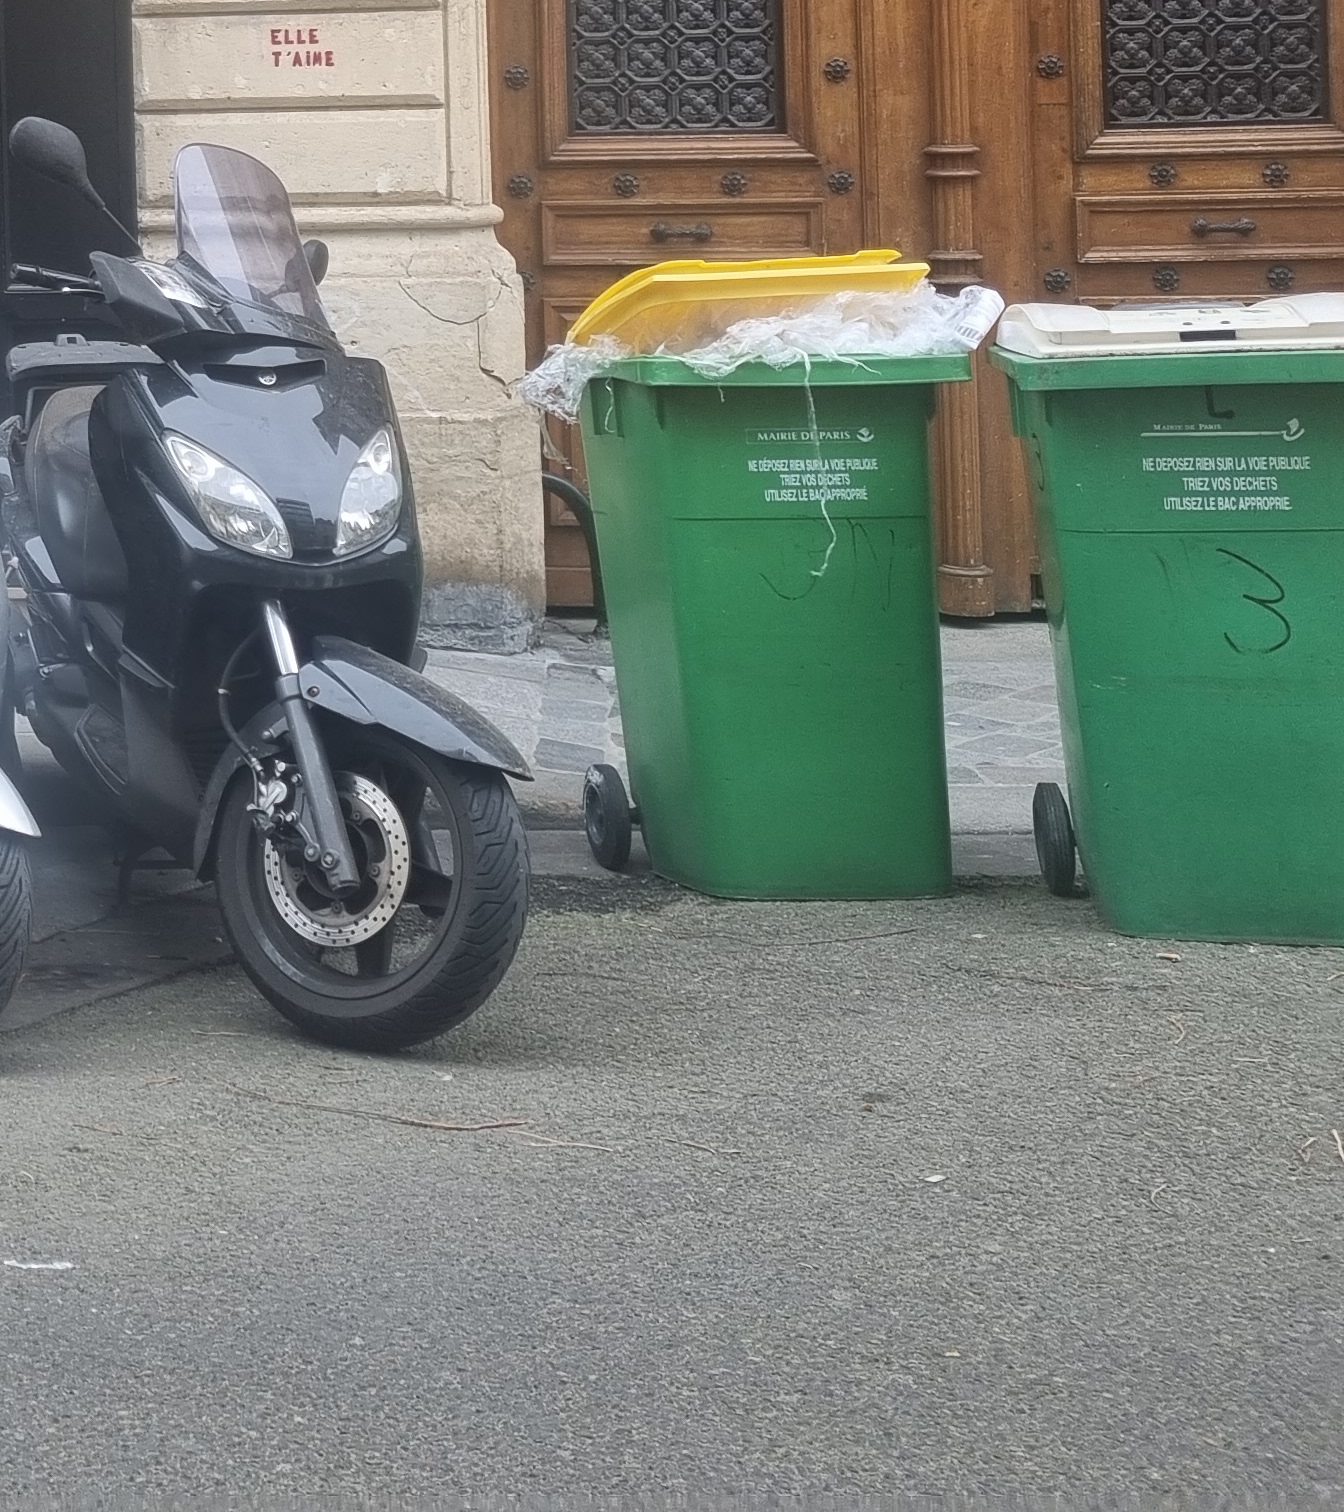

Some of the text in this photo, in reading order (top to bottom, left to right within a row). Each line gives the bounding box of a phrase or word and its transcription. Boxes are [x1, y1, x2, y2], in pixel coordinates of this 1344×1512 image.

[270, 29, 319, 45] ELLE
[757, 431, 797, 441] MAIRIE
[819, 431, 851, 440] PARIS
[748, 460, 758, 471] NE
[790, 459, 805, 471] RIEN
[830, 459, 845, 470] VOIE
[846, 458, 878, 470] PUBLIQUE
[1142, 456, 1311, 472] NE DEPOSEZ RIEN SUR LA VOIE PUBLIQUE
[780, 474, 801, 486] TRIEZ
[802, 474, 816, 486] VOS
[1182, 476, 1278, 491] TRIEZ VOS DECHETS
[764, 489, 797, 501] UTILISEZ
[798, 490, 808, 501] LE
[1164, 497, 1204, 511] UTILISEZ
[1205, 497, 1217, 510] LE
[1219, 497, 1237, 510] BAC
[1216, 548, 1291, 655] 3
